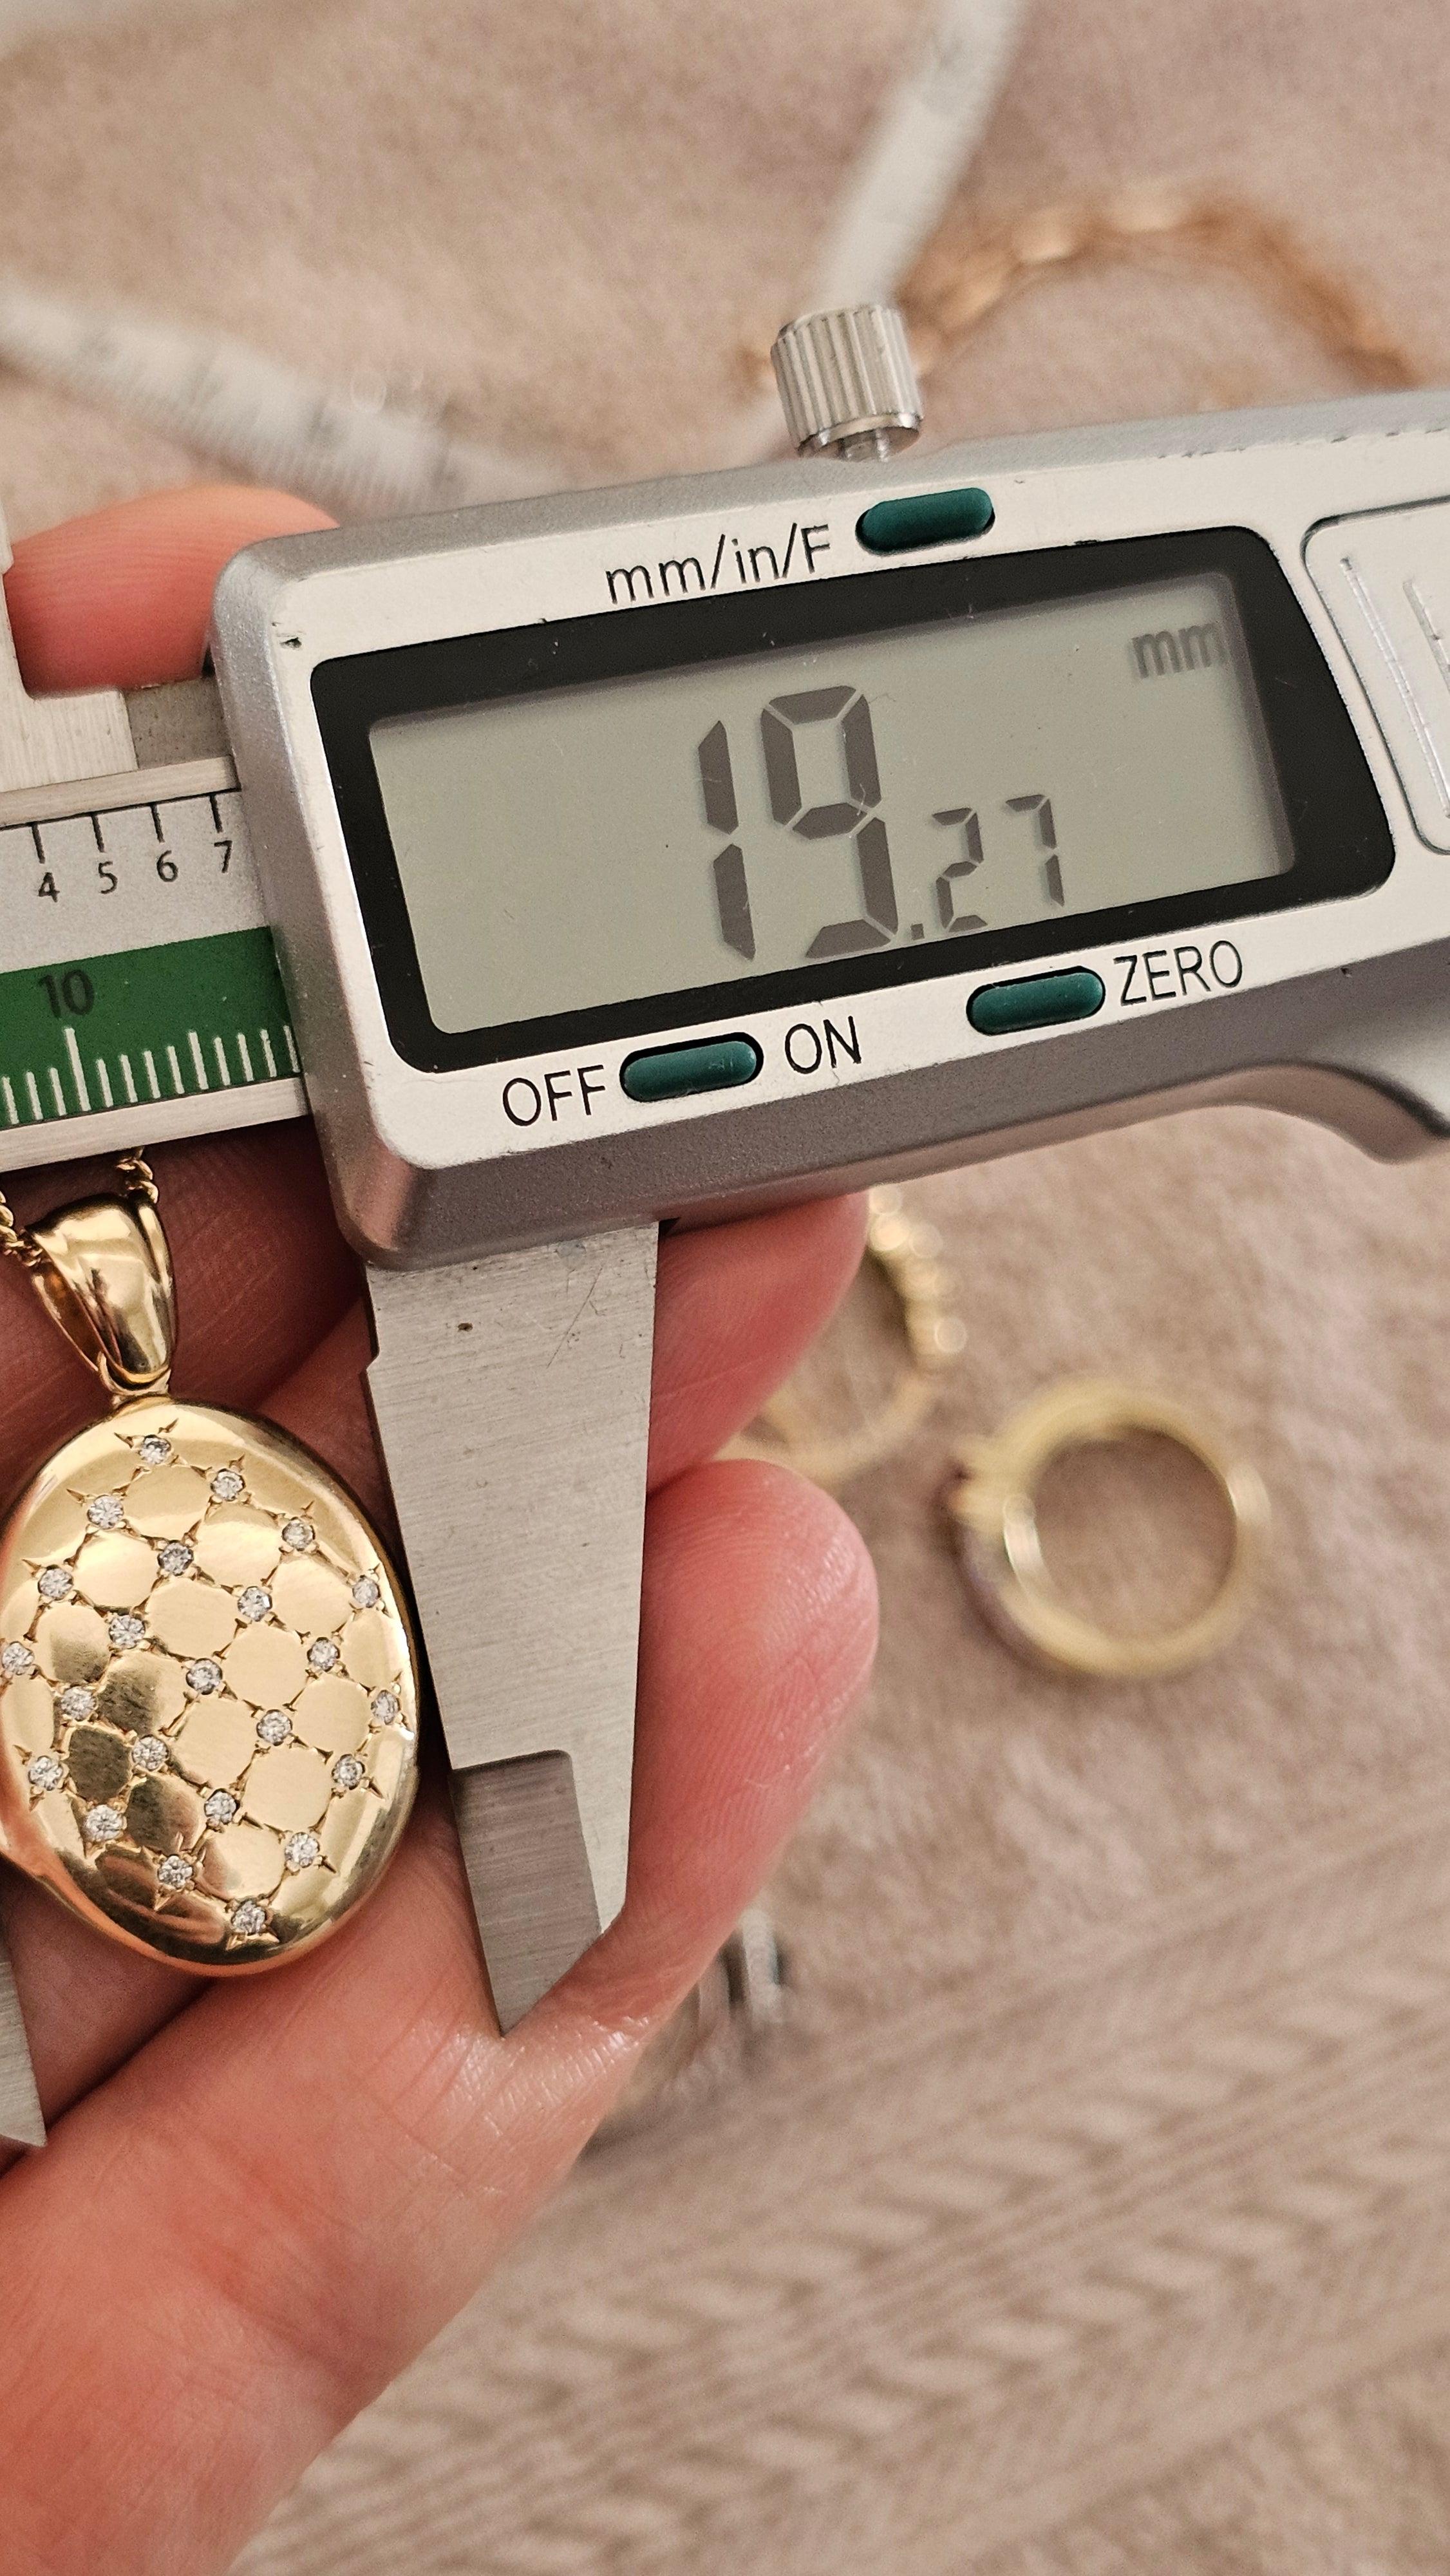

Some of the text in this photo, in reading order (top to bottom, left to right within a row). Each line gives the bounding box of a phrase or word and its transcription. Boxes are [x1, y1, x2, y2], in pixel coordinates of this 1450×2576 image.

[605, 522, 833, 605] mm/in/F
[1131, 620, 1226, 680] mm
[697, 685, 1065, 961] 19.27
[38, 840, 232, 902] 4 5 6 7
[38, 968, 95, 1019] 10
[1114, 940, 1243, 1006] ZERO
[502, 1016, 862, 1126] OFF ON
